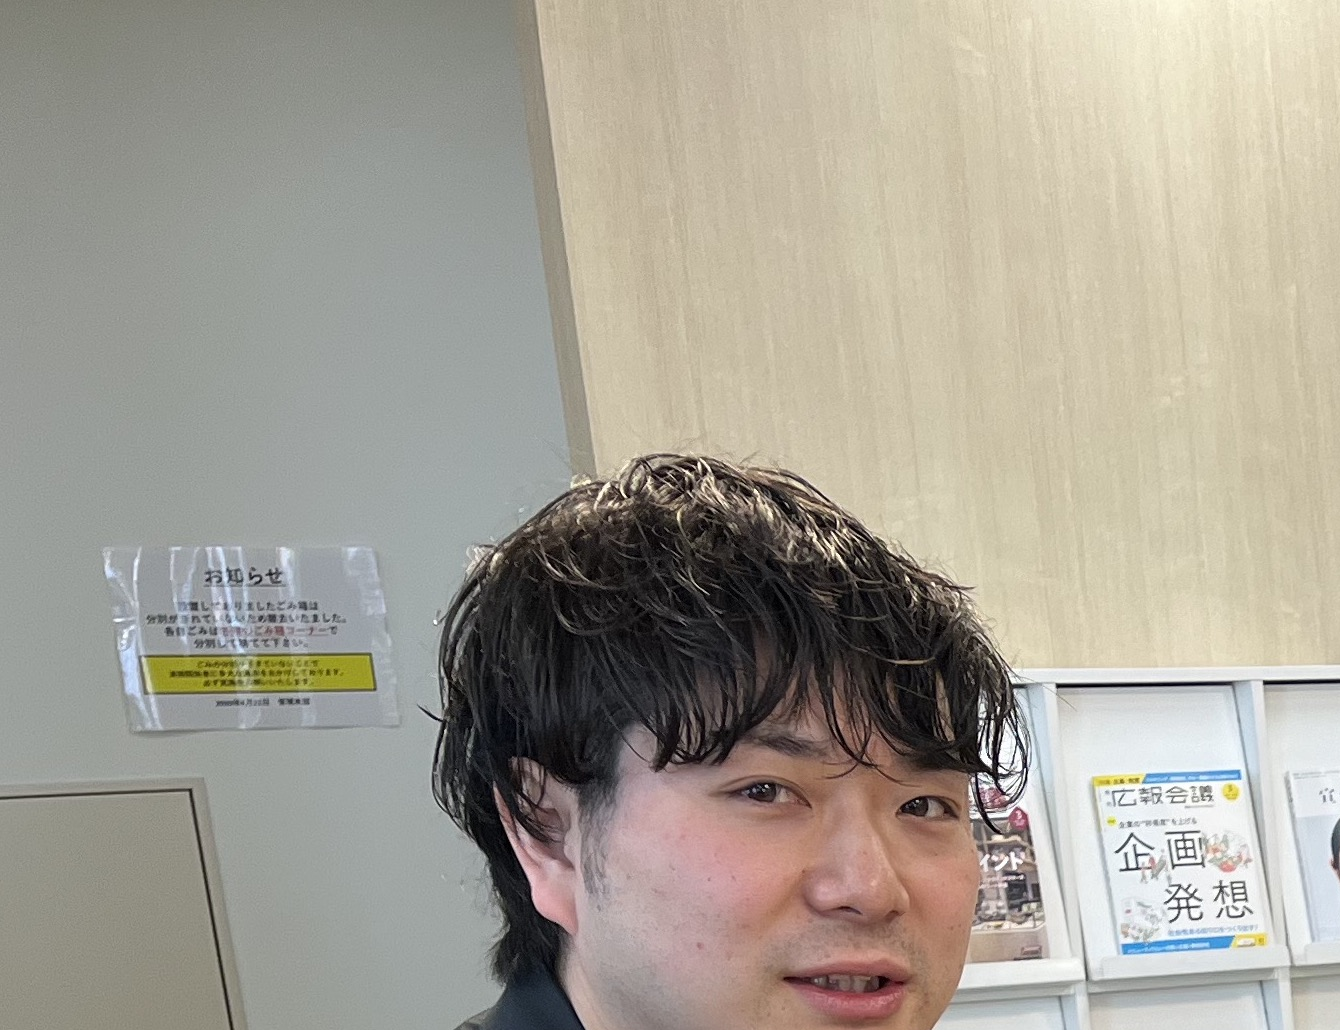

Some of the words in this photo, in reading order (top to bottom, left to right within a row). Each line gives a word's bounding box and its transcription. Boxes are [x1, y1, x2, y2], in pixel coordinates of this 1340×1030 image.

[204, 566, 285, 585] お知らせ
[1111, 784, 1215, 807] 広報会議
[1114, 829, 1206, 873] 企画
[1163, 879, 1254, 924] 発想
